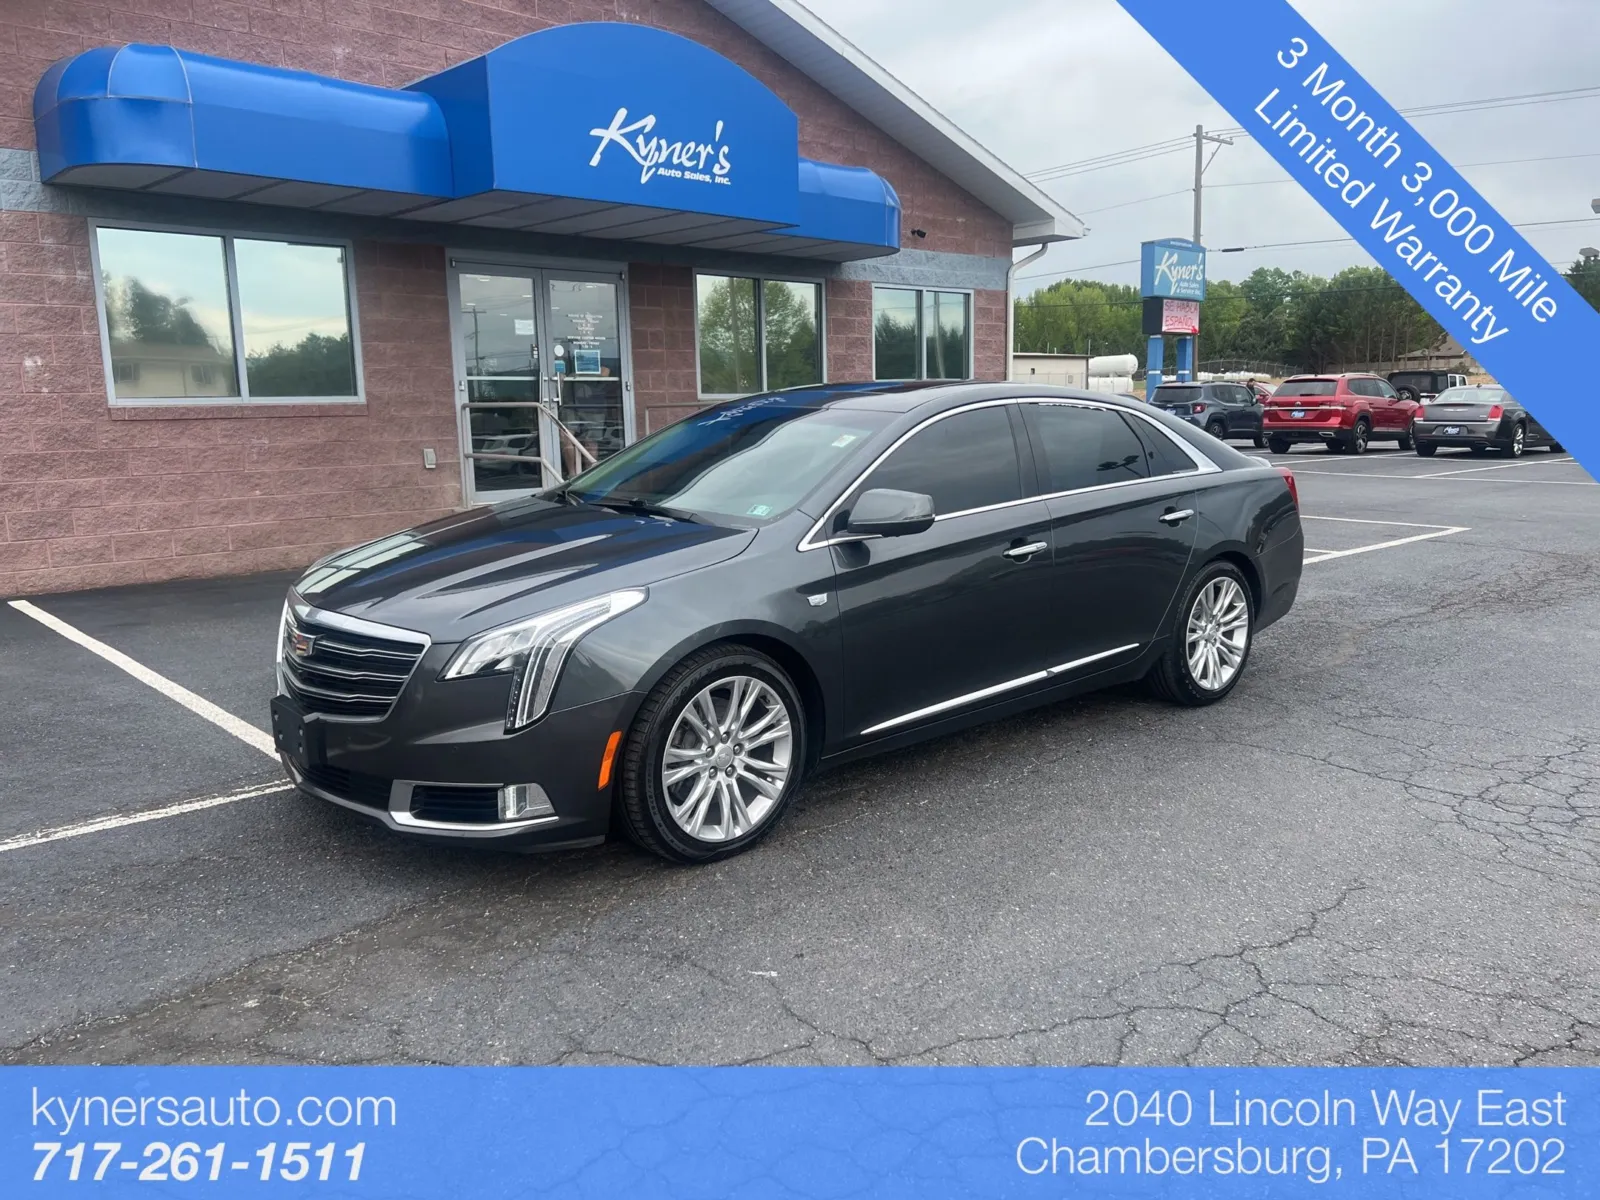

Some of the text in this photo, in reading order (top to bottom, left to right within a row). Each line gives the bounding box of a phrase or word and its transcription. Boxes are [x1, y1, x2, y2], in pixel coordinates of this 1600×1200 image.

[589, 107, 731, 185] Kyner's
[657, 167, 682, 178] Auto
[683, 171, 713, 184] Sales,
[1154, 251, 1203, 295] Kyner's
